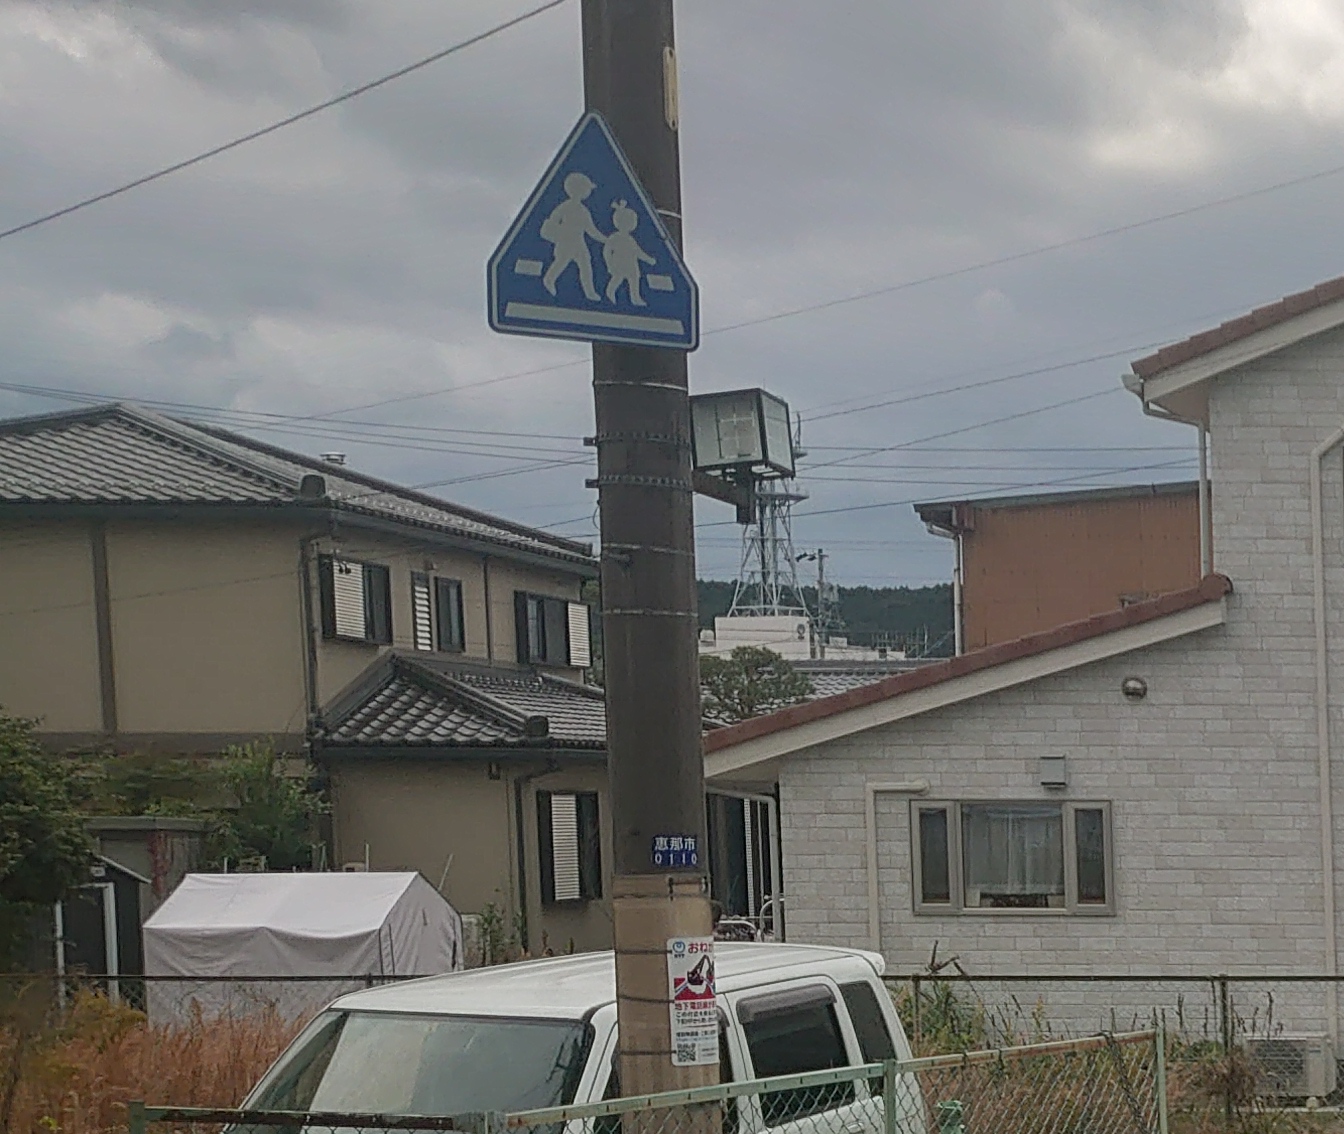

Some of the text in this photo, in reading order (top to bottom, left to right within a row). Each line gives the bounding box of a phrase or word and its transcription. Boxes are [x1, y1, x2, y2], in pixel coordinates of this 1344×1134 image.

[654, 836, 697, 851] 恵那市
[654, 853, 698, 865] 0110
